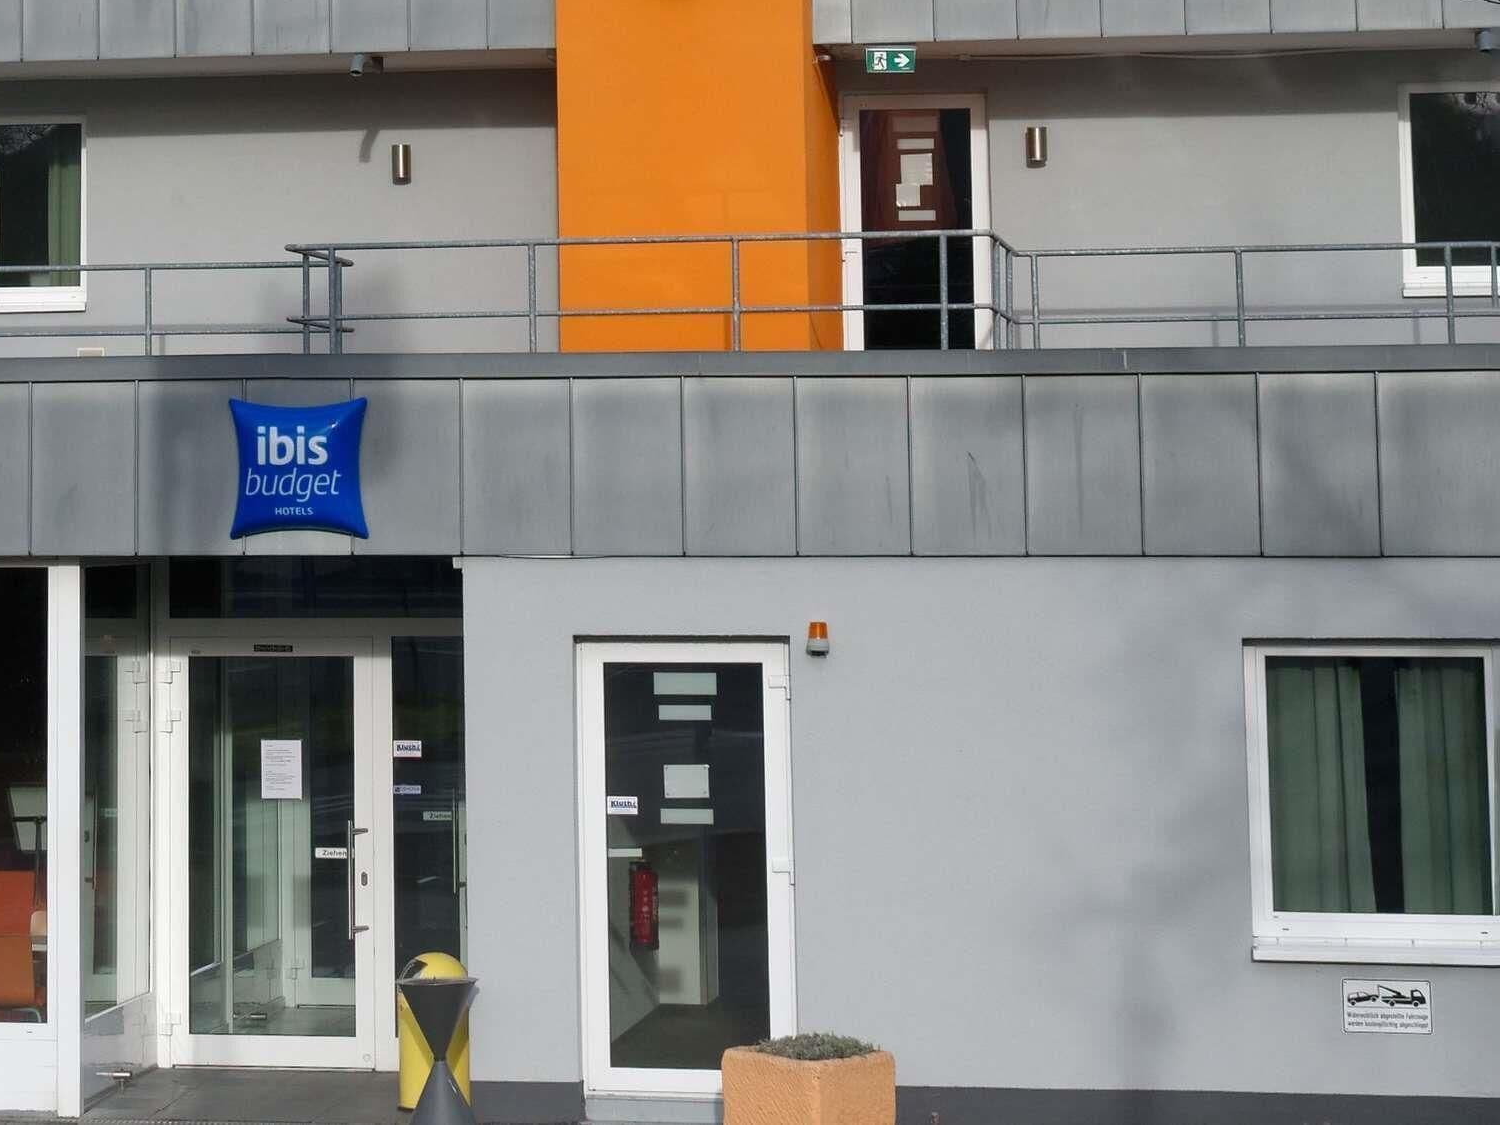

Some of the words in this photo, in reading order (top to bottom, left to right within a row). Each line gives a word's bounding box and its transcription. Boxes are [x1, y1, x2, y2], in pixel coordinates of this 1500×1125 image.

[256, 425, 329, 466] ibis
[245, 467, 342, 502] budget
[274, 506, 314, 516] HOTELS
